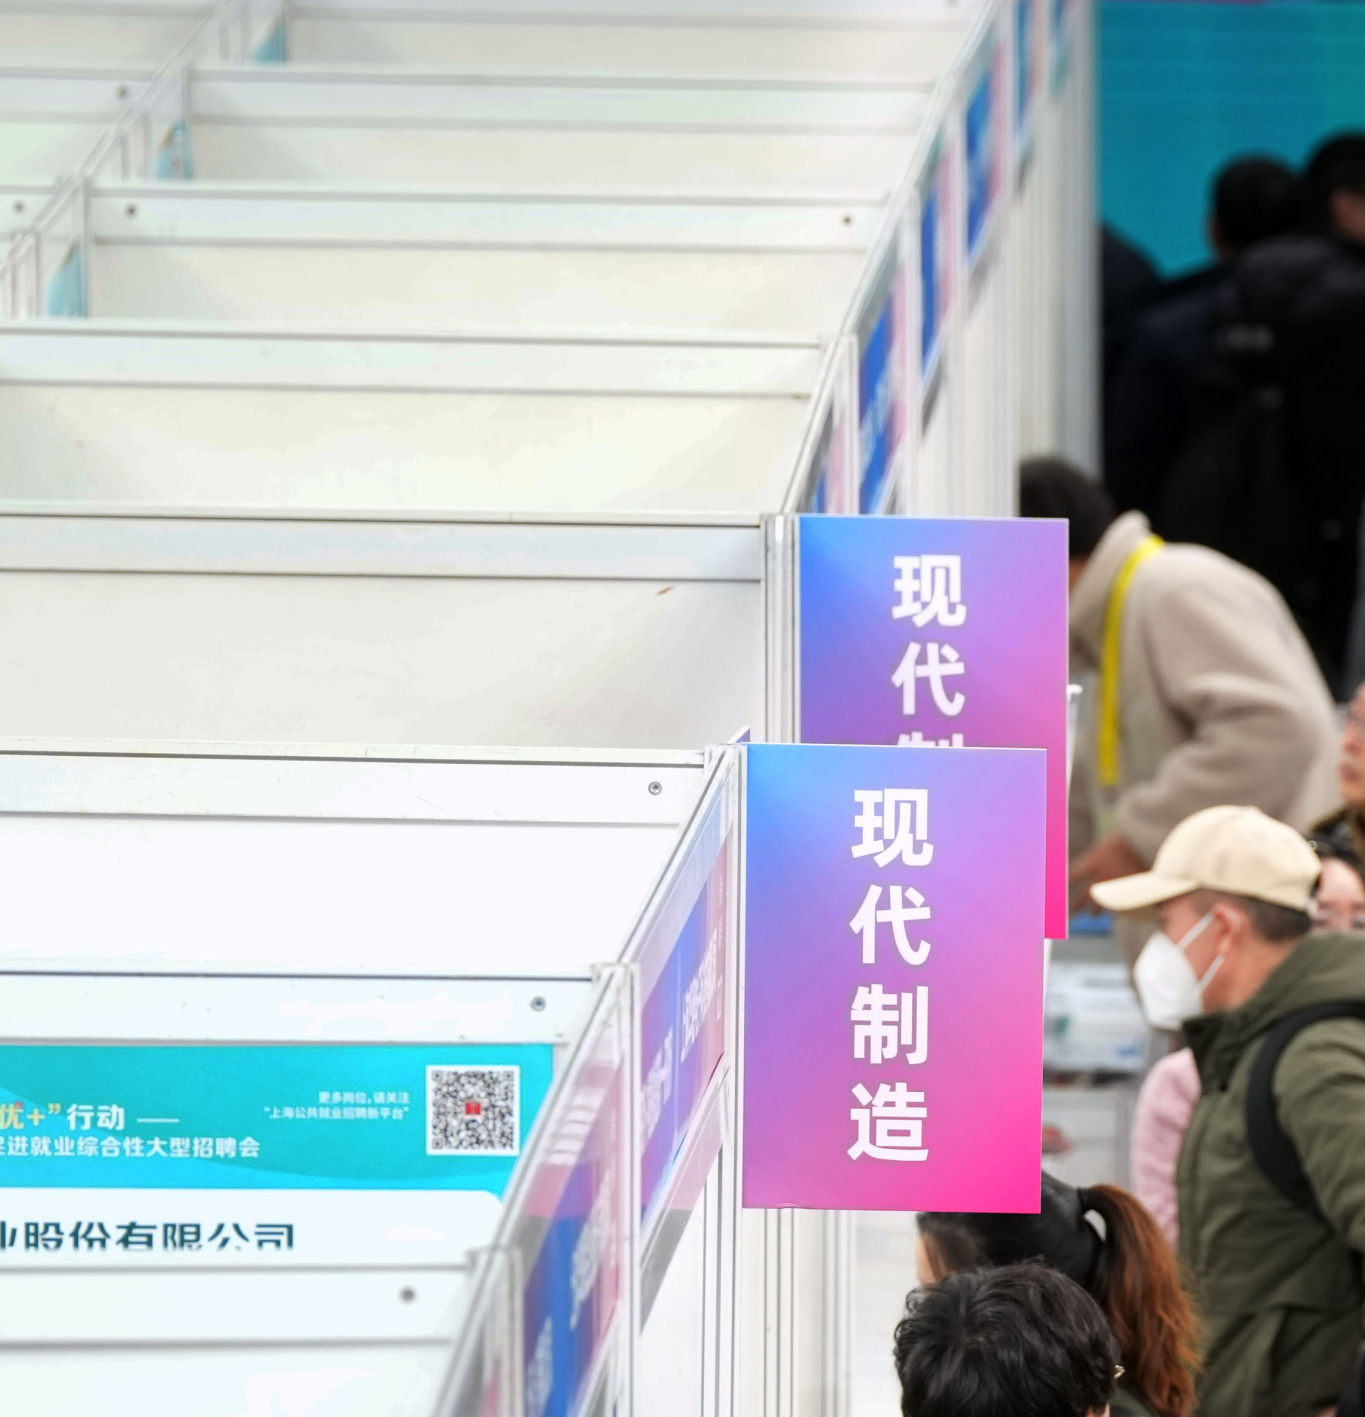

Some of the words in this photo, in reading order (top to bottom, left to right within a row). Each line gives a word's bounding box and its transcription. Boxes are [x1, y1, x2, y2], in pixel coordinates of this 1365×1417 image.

[891, 554, 967, 746] 现代
[847, 788, 934, 1162] 现代制造
[0, 1136, 260, 1158] 进就业综合性大型招聘会
